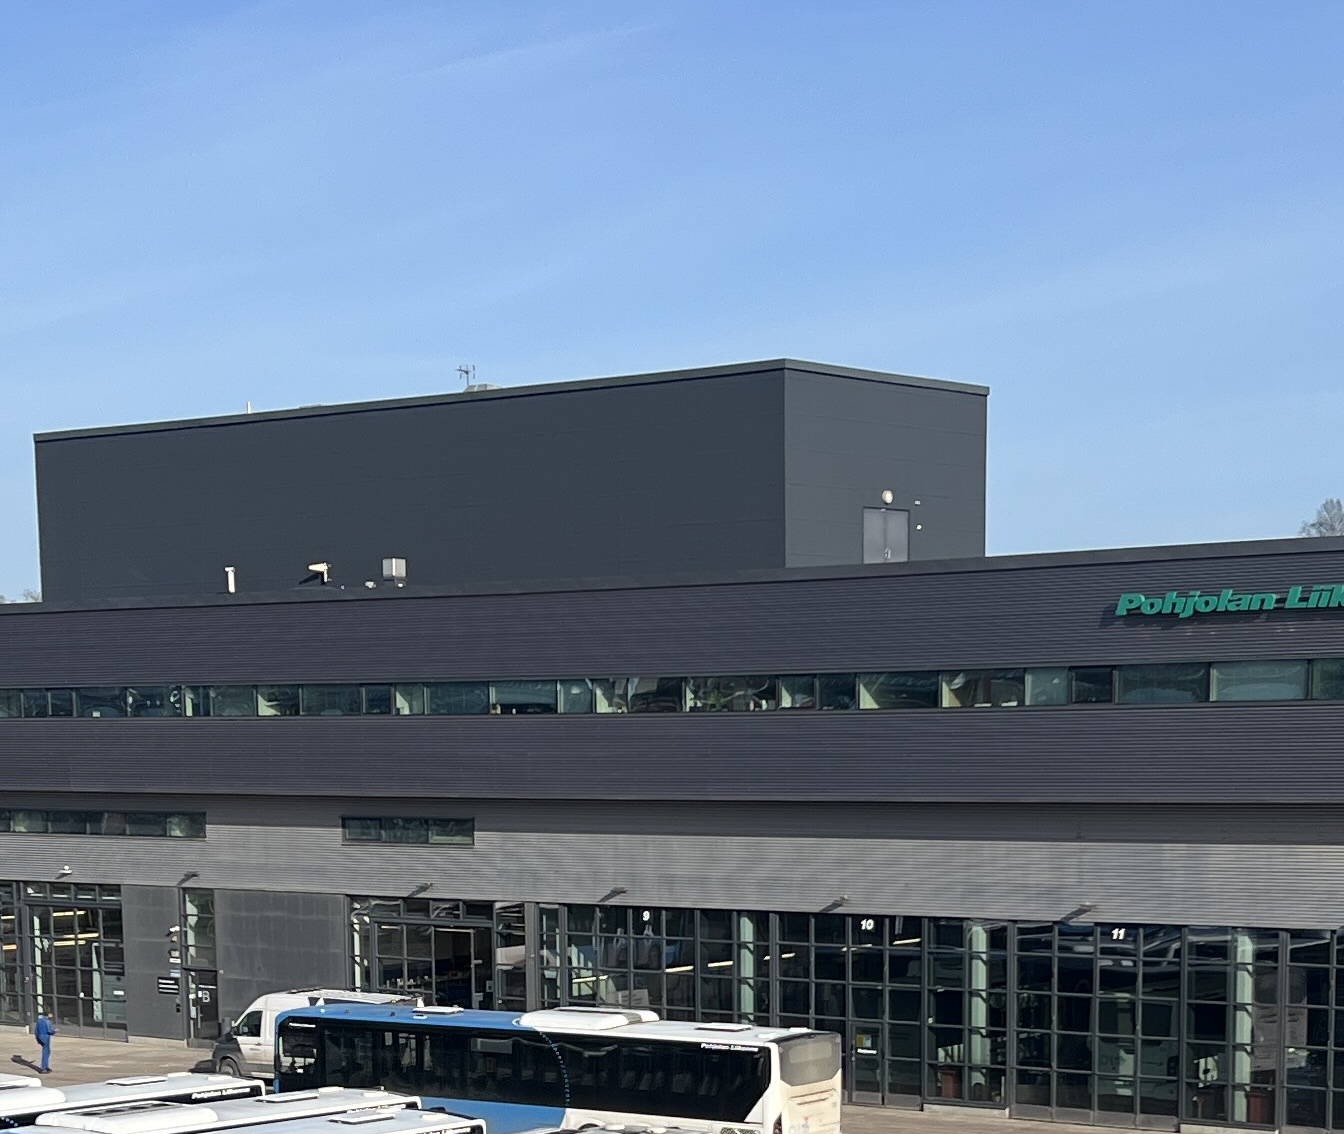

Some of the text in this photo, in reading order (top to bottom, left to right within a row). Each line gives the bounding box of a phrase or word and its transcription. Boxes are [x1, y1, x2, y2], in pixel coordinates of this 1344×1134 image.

[1115, 589, 1277, 618] Pohjolan
[642, 910, 650, 921] 9
[860, 919, 874, 930] 10
[1111, 928, 1126, 940] 11
